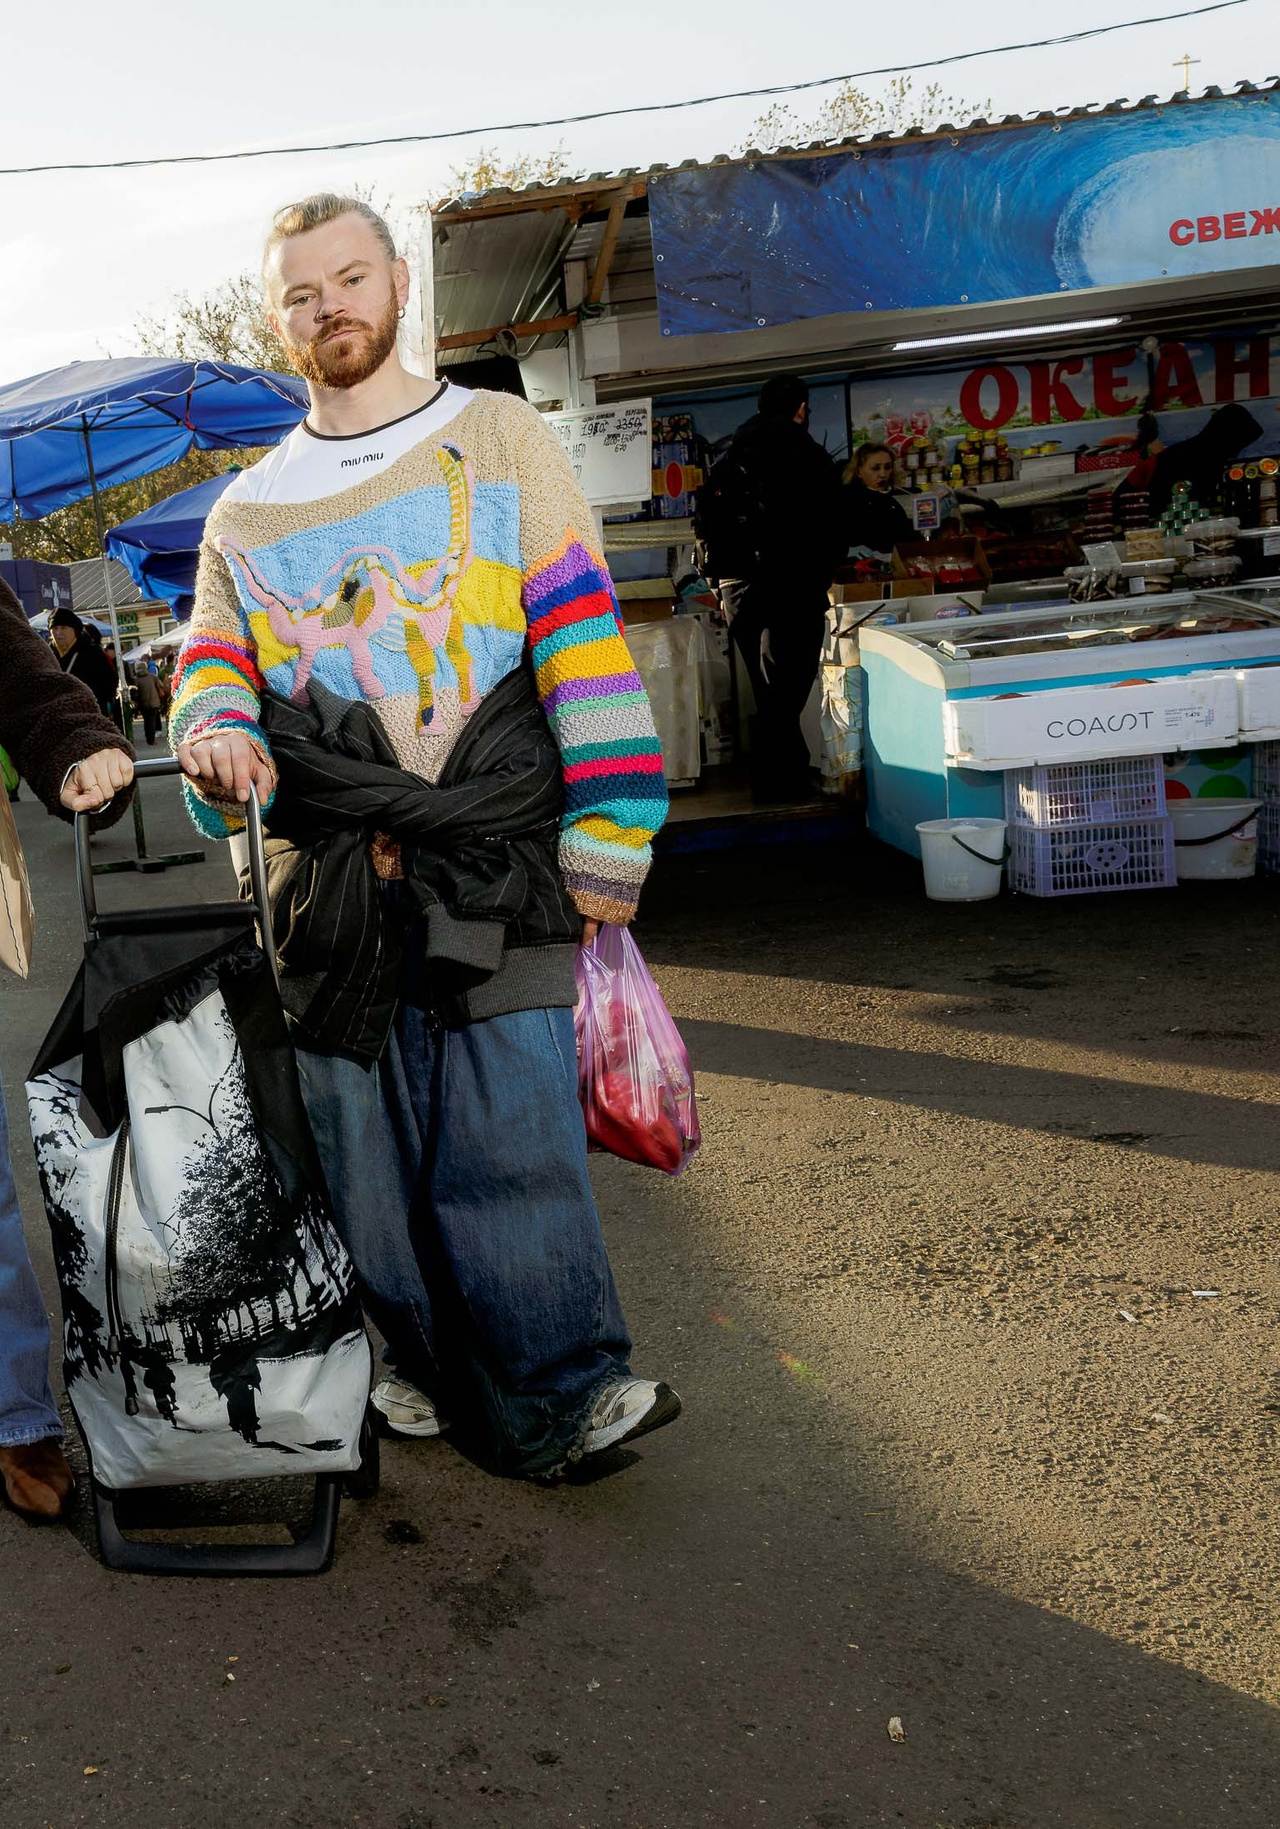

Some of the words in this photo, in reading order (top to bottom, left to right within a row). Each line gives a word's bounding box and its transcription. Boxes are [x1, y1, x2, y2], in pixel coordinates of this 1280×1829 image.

[959, 335, 1270, 430] ОКЕАН
[341, 457, 361, 468] miu
[363, 452, 384, 463] miu
